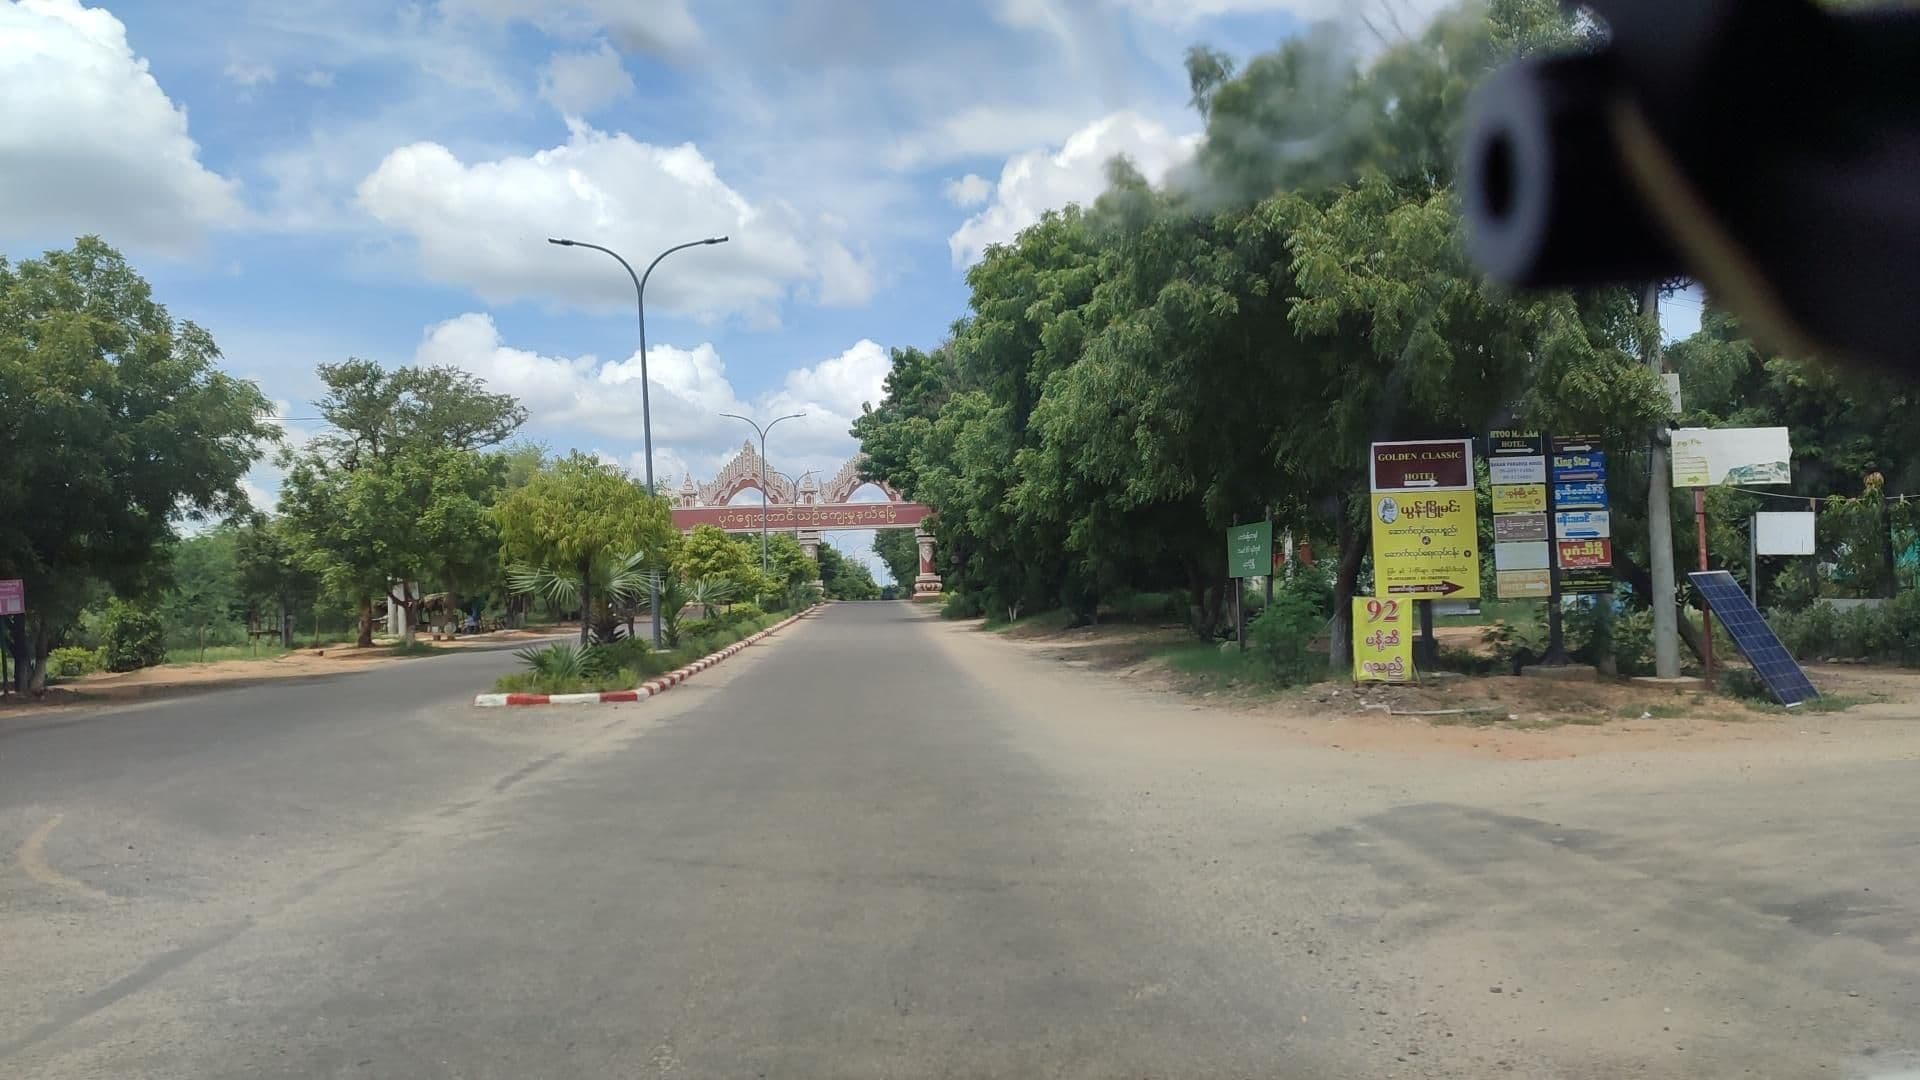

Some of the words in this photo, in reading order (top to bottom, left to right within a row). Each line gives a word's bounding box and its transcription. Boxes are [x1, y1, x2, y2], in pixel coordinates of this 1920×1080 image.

[1501, 440, 1528, 448] HOTEL
[1378, 452, 1417, 462] GOLDEN
[1421, 451, 1462, 461] CLASSIC
[1553, 456, 1573, 469] King
[1573, 455, 1590, 467] Star
[1404, 472, 1438, 482] HOTEL
[1367, 600, 1399, 623] 92
